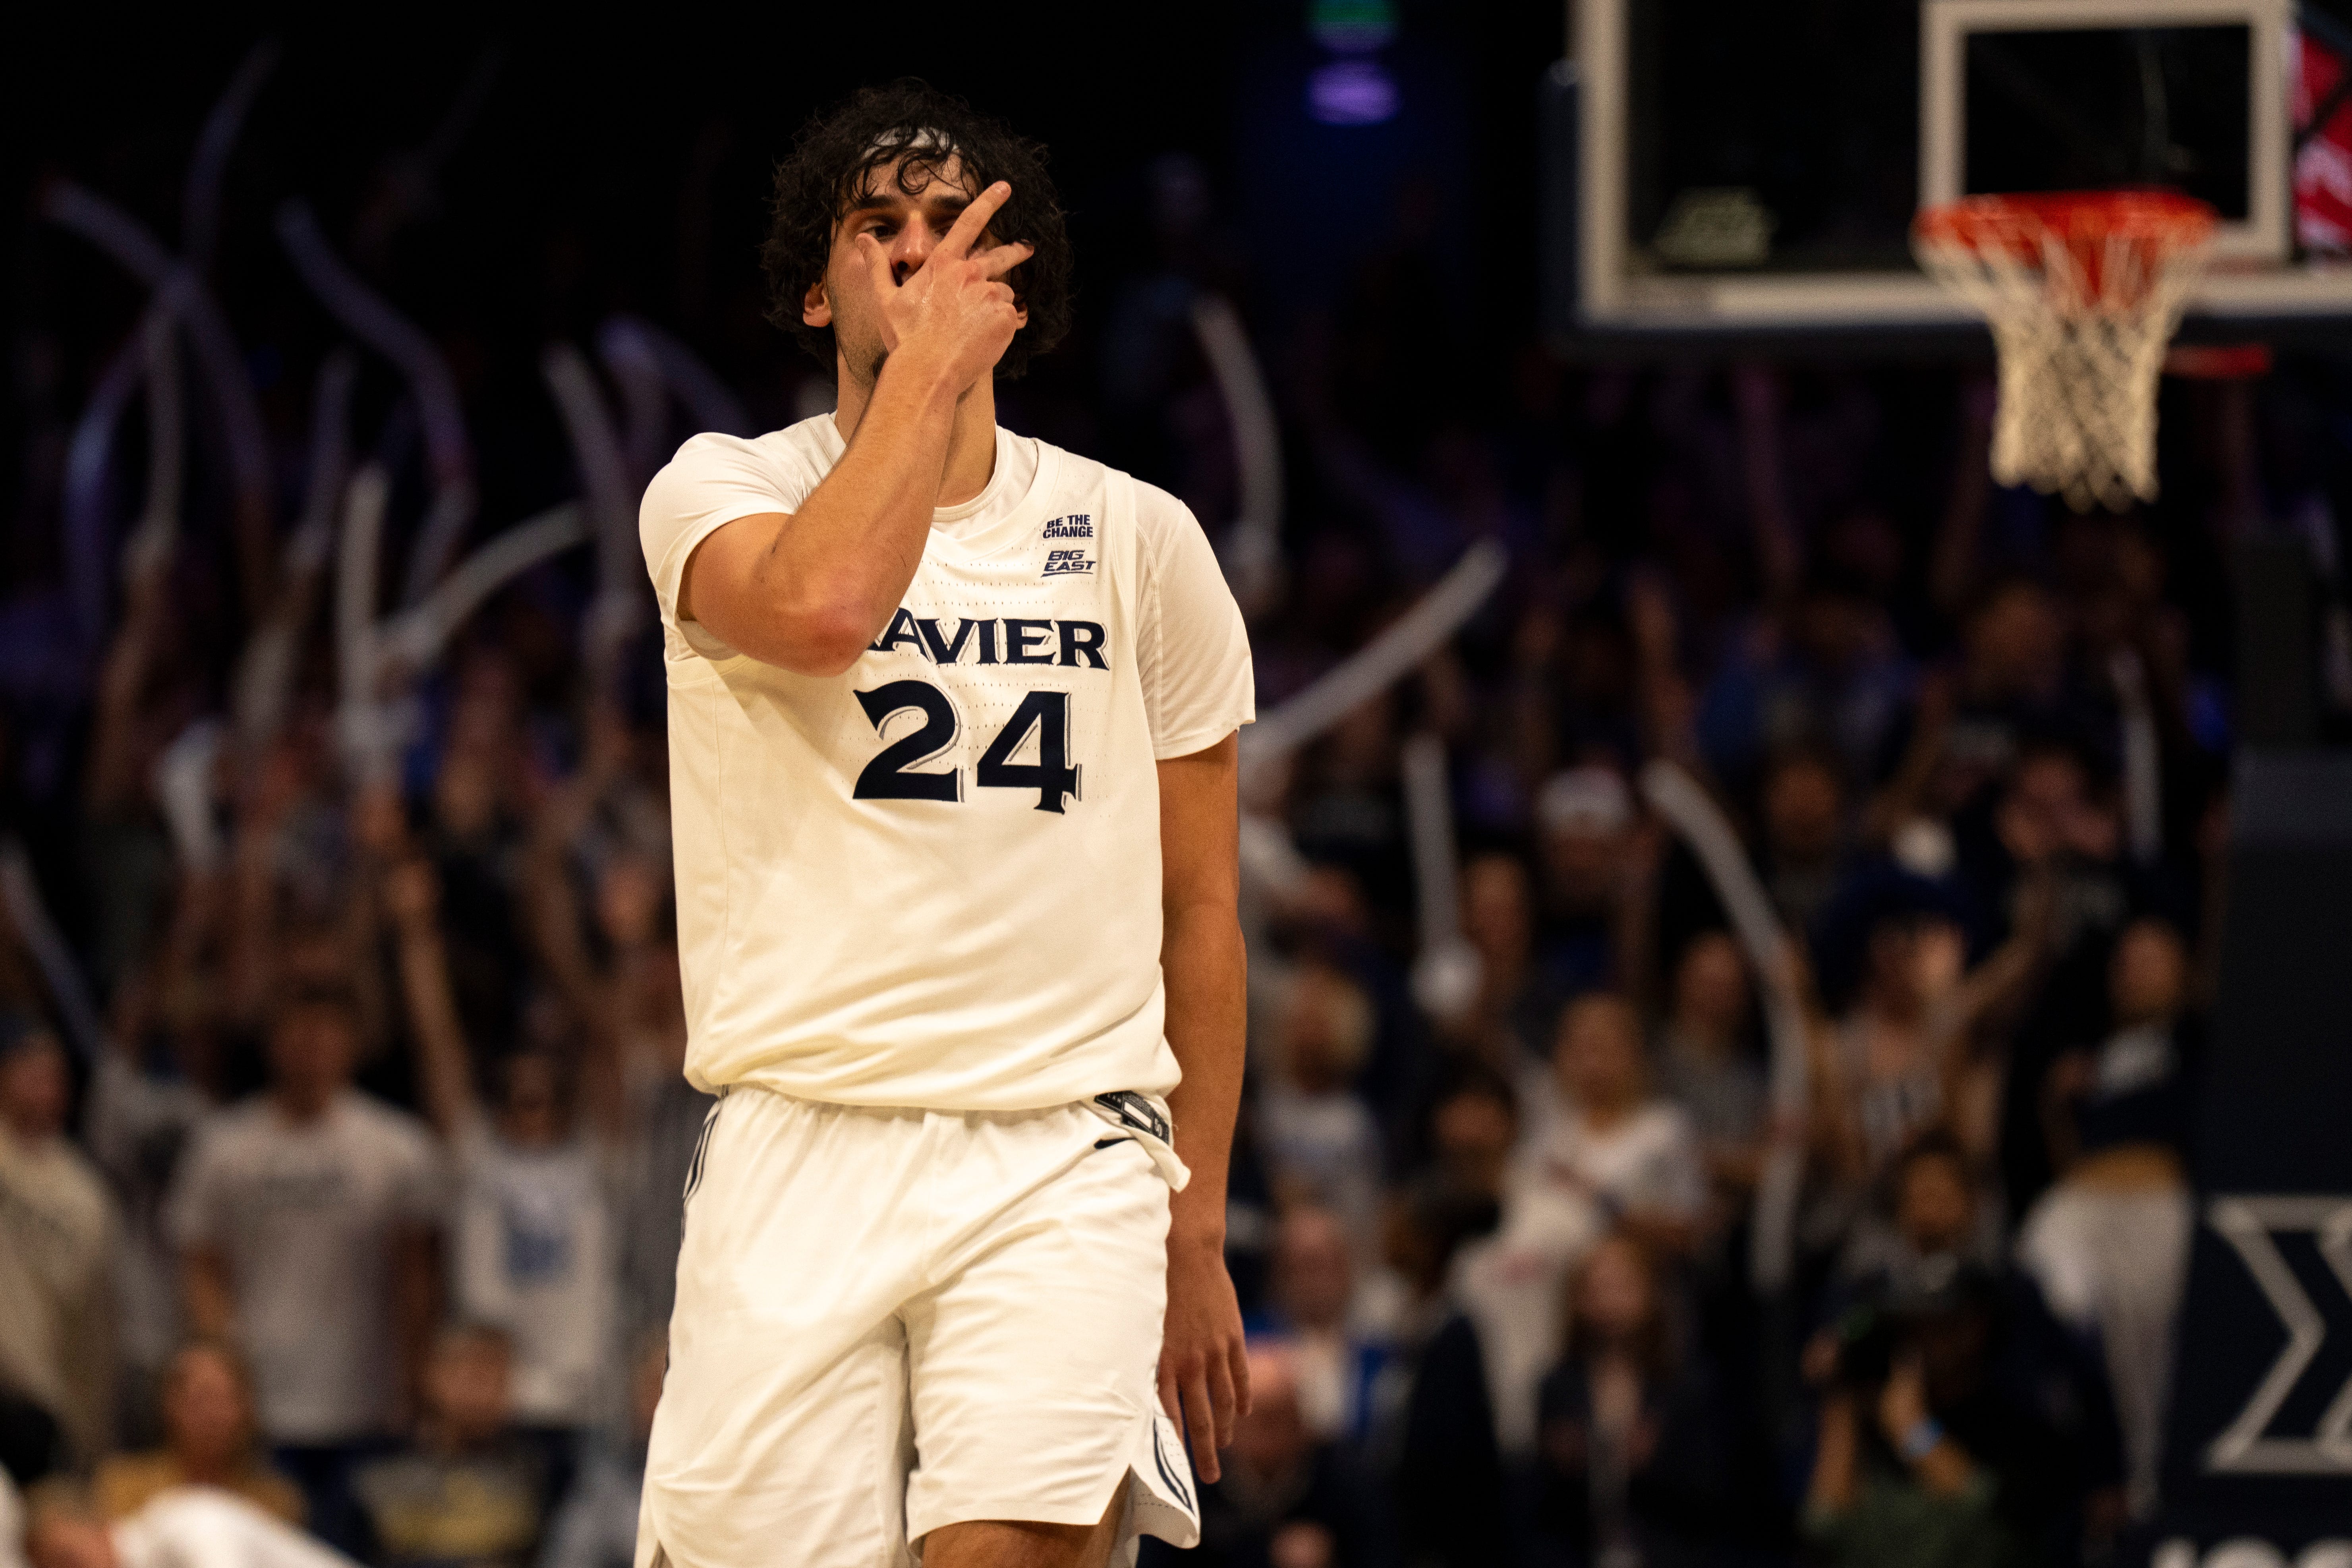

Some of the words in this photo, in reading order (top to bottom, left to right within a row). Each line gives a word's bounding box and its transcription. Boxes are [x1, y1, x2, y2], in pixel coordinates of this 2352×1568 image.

[1047, 517, 1063, 529] BE
[1067, 514, 1090, 525] THE
[1043, 526, 1093, 539] CHANGE
[1048, 550, 1085, 561] BIG
[1044, 561, 1096, 571] EAST
[867, 607, 1110, 671] AVIER
[852, 680, 1082, 815] 24
